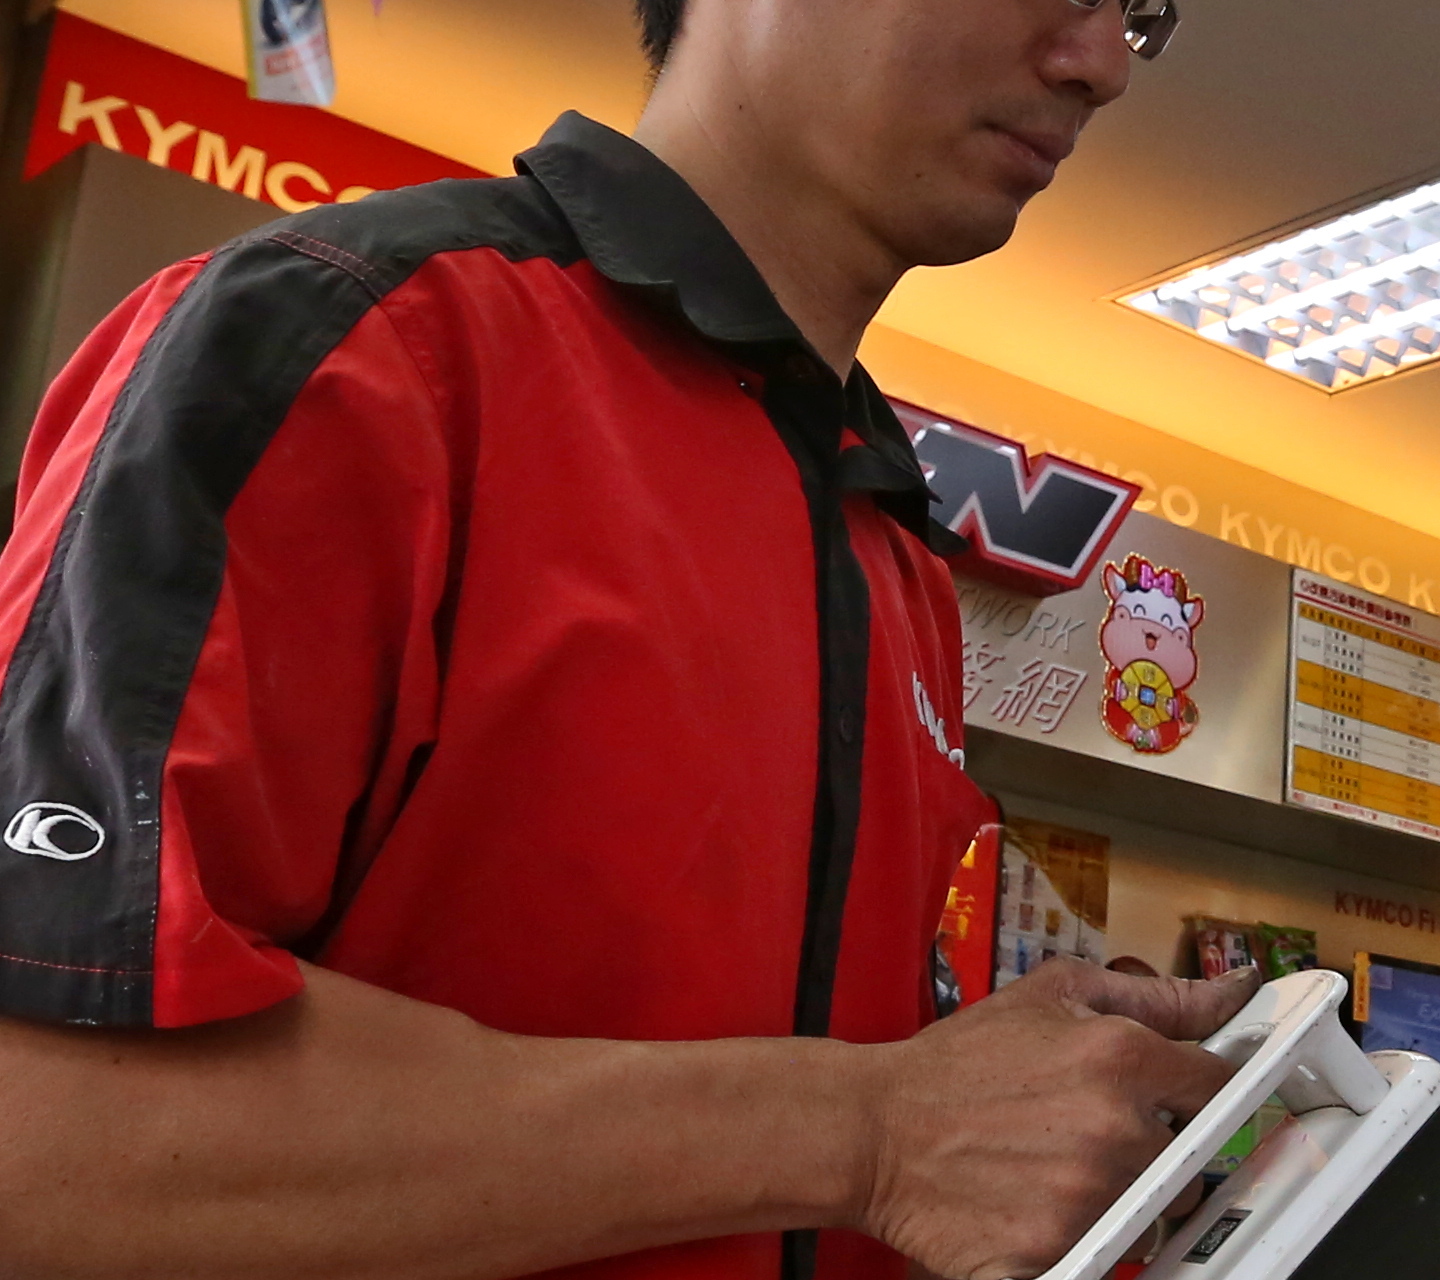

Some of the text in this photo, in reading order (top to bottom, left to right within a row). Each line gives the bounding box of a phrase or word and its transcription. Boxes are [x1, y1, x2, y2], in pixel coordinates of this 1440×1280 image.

[59, 81, 376, 214] KYMC
[1219, 503, 1393, 595] KYMCO
[1334, 890, 1419, 929] KYMCO
